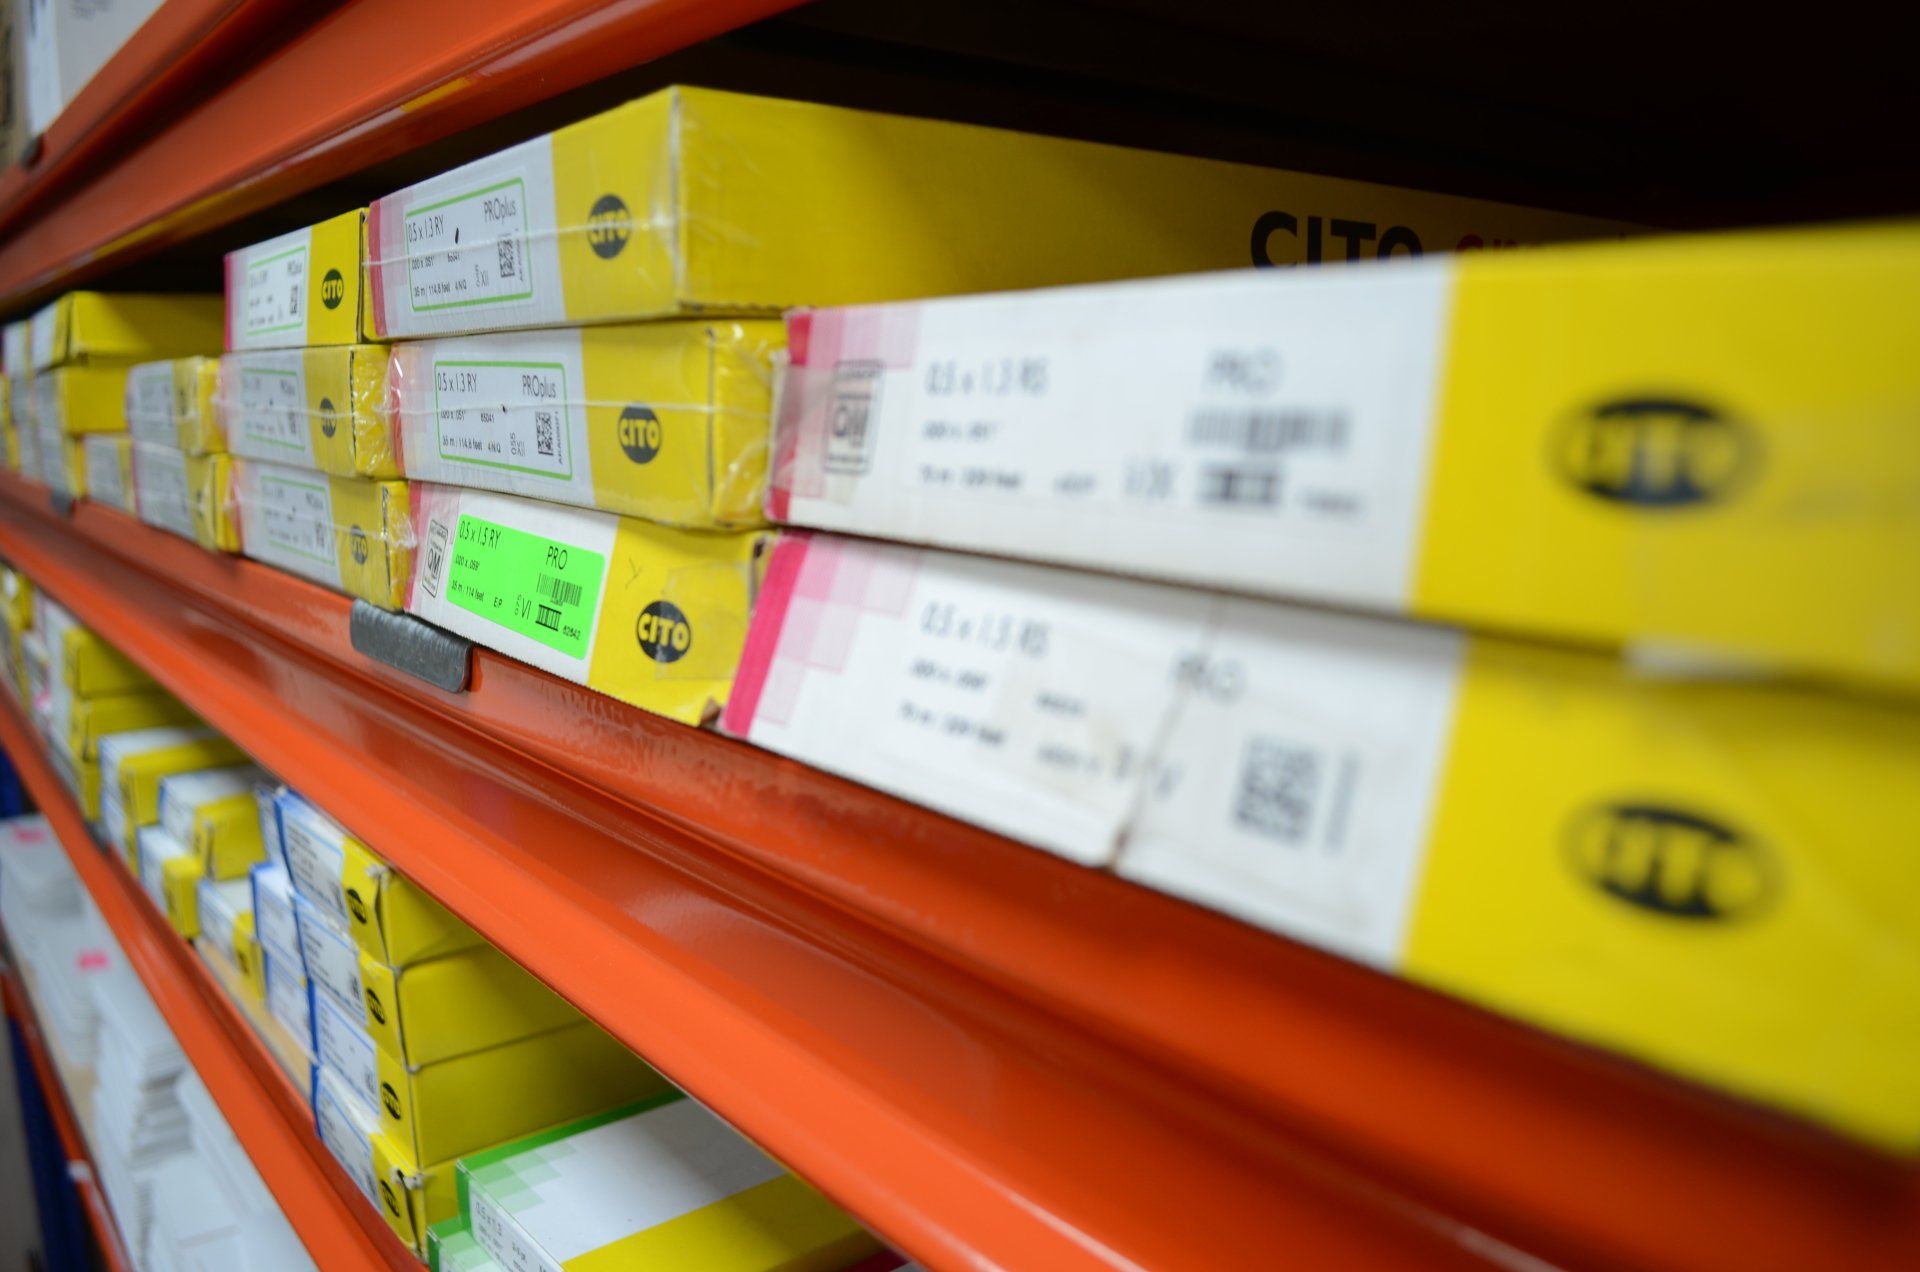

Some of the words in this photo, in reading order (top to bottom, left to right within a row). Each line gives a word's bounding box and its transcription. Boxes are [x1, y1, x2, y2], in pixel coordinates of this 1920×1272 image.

[483, 196, 517, 225] PROplus
[435, 214, 444, 236] RY
[322, 278, 343, 300] CITO
[467, 373, 477, 393] RY
[522, 375, 556, 400] PROplus
[619, 418, 660, 449] CITO
[488, 529, 502, 550] RY
[546, 546, 568, 570] PRO
[637, 613, 691, 652] CITO
